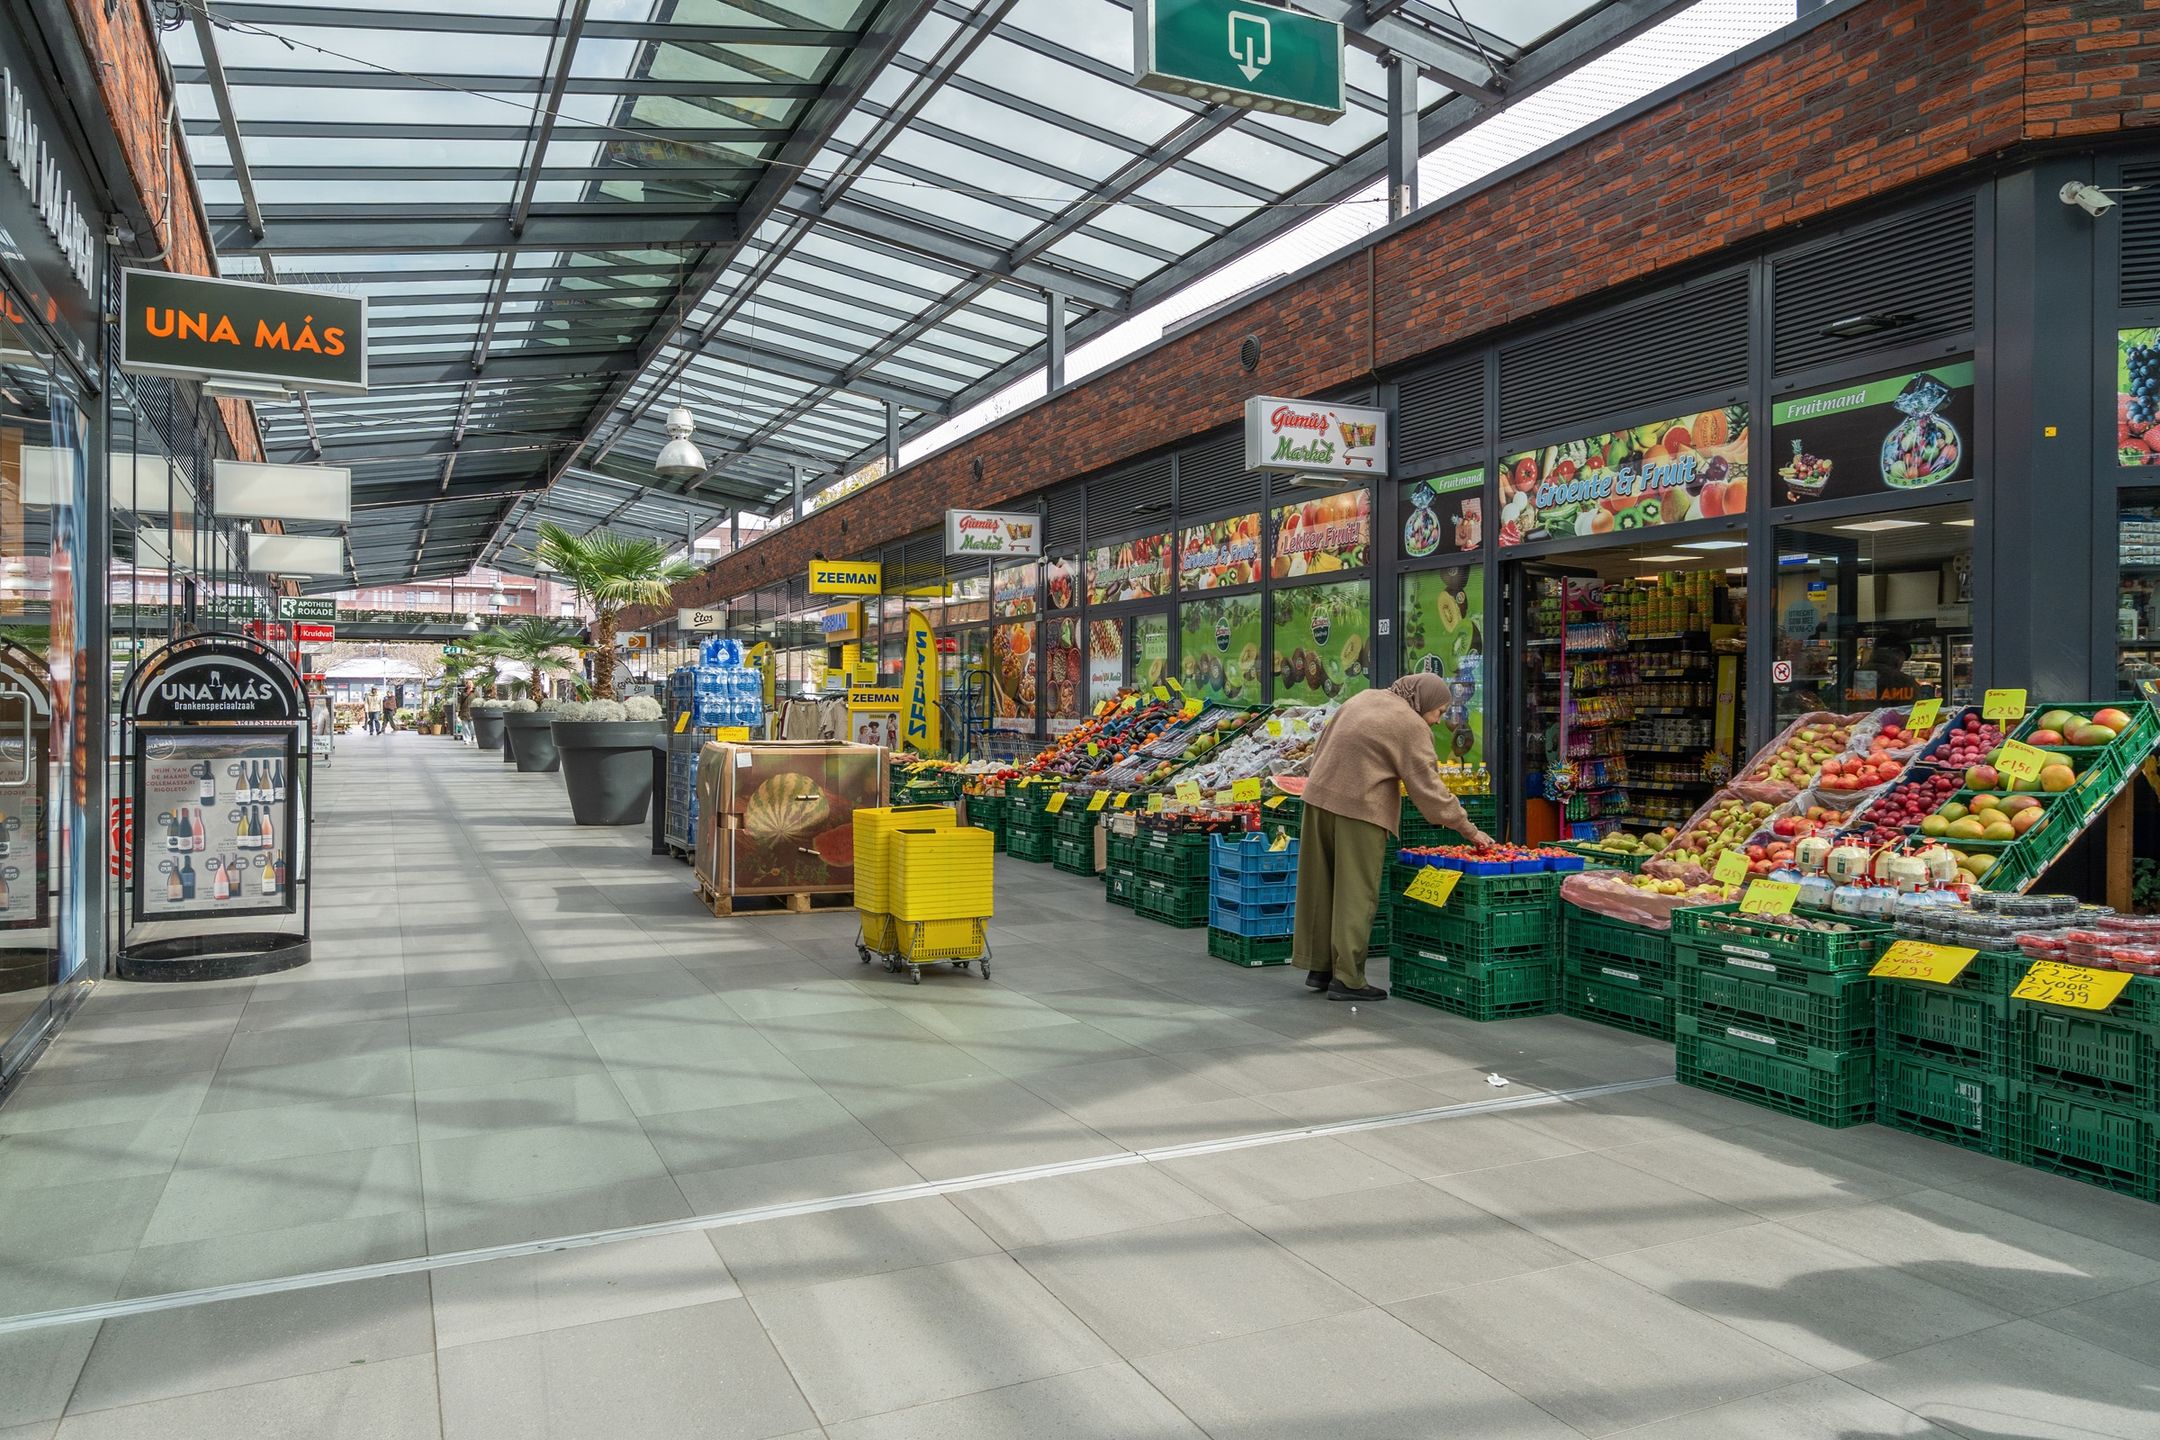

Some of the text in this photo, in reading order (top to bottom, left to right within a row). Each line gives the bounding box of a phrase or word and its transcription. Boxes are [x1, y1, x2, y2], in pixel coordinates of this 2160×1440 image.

[145, 306, 346, 356] UNA MÁS
[1786, 389, 1866, 419] Fruitmand
[1271, 406, 1329, 436] Gümüş
[1271, 435, 1335, 464] Market
[1438, 470, 1483, 491] Fruitmand
[1535, 455, 1698, 509] Groente & Fruit
[959, 514, 1000, 534] Gümüş
[958, 534, 1004, 550] Market
[1283, 521, 1360, 555] Lekker Fruit!
[1183, 542, 1257, 571] Groente & Fruit
[817, 571, 877, 584] ZEEMAN
[297, 607, 334, 616] ROKADE
[693, 612, 714, 623] Etos
[303, 629, 333, 637] Kruidvat
[1379, 622, 1388, 633] 20
[161, 678, 273, 700] UNA MÁS
[852, 693, 899, 704] ZEEMAN
[174, 701, 255, 711] Drankenspeciaalzaak
[2042, 978, 2092, 992] VOOR
